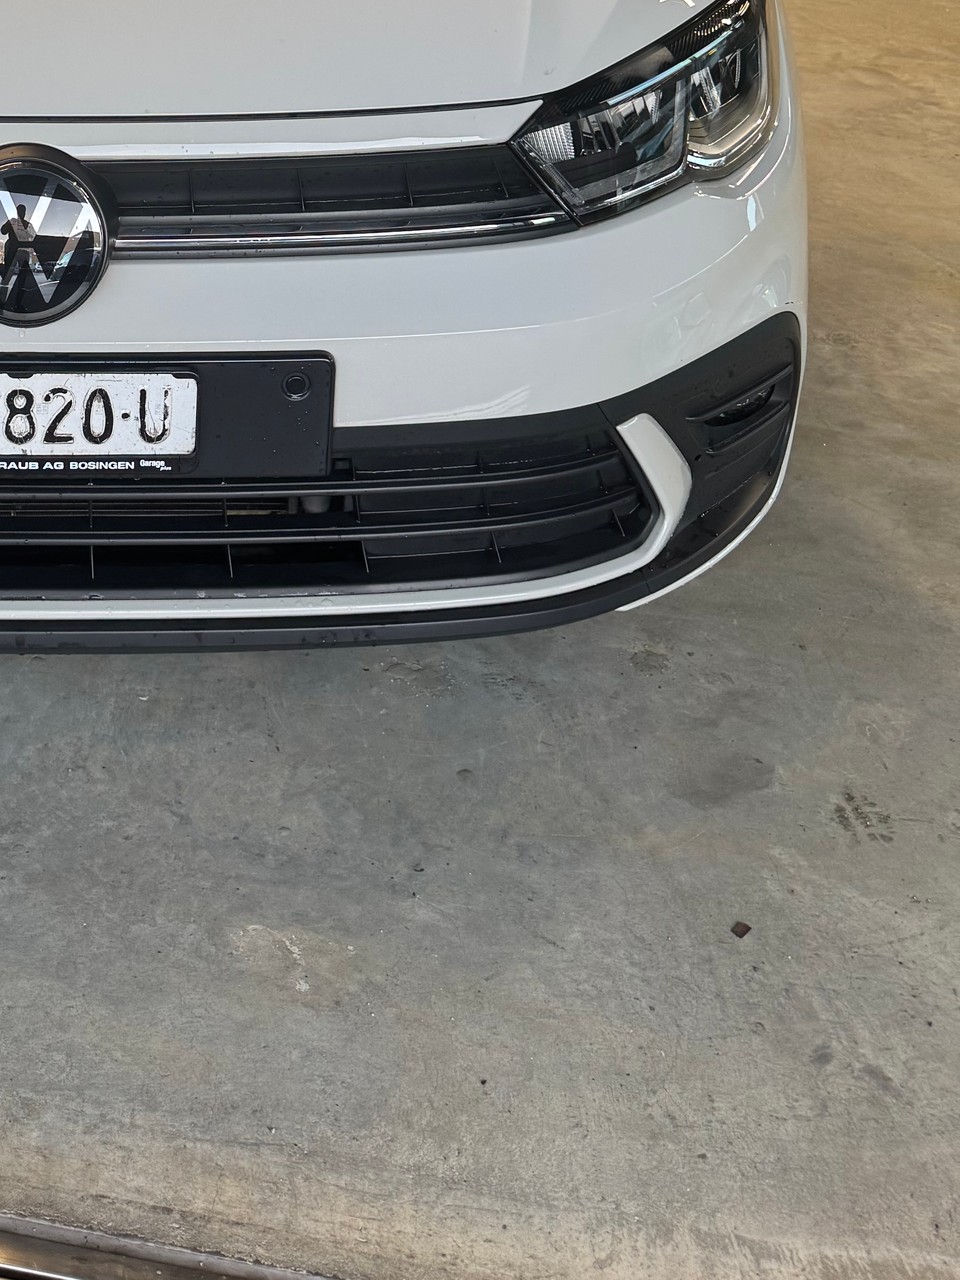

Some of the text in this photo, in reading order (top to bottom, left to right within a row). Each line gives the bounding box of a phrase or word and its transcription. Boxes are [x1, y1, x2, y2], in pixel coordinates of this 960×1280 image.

[43, 461, 65, 470] AG
[69, 461, 135, 470] BOSINGEN
[140, 460, 165, 469] Garage
